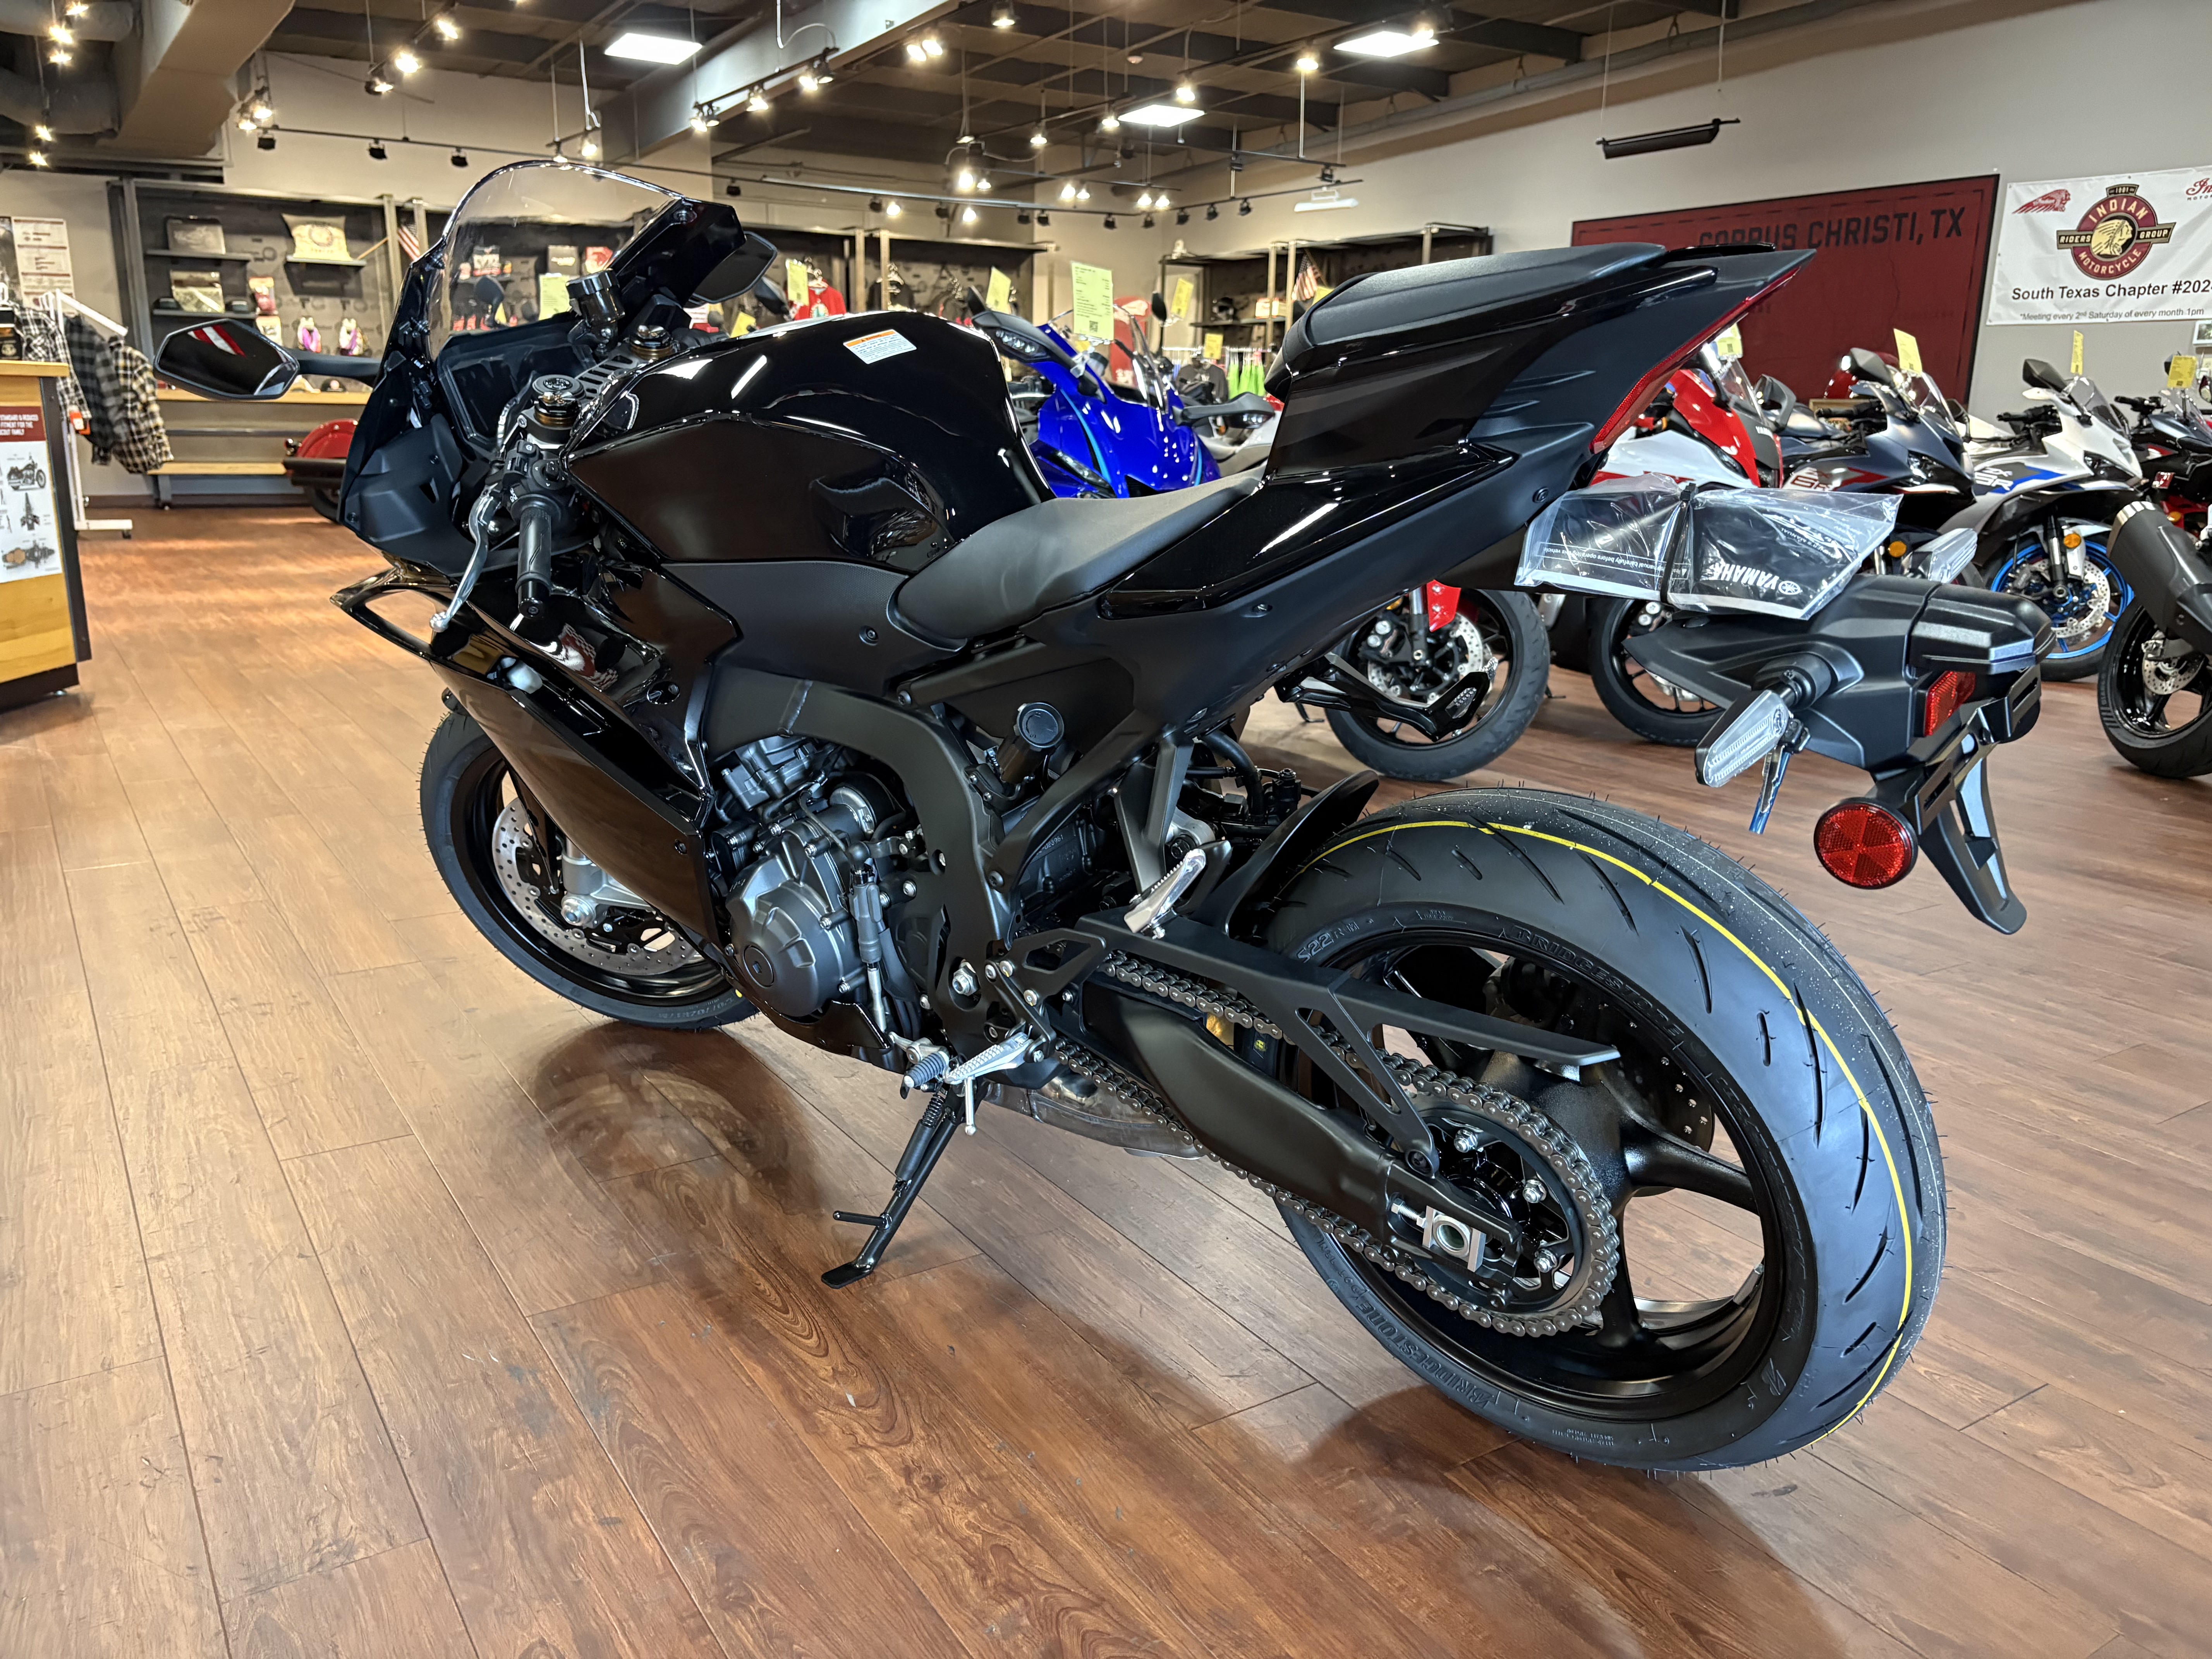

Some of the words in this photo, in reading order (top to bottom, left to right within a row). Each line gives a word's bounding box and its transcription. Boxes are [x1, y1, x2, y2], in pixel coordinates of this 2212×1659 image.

[2088, 198, 2148, 223] INDIAN
[1808, 212, 1923, 248] CHRISTI,
[1930, 206, 1965, 239] TX
[2059, 235, 2091, 243] RIDERS
[2140, 229, 2168, 239] GROUP
[2078, 249, 2142, 274] MOTORCYCLE
[2012, 287, 2054, 300] South
[2059, 286, 2100, 299] Texas
[2106, 284, 2168, 299] Chapter
[2172, 279, 2212, 294] #202
[2088, 311, 2123, 319] Saturday
[1597, 555, 1615, 564] before
[1356, 1301, 1491, 1409] BRIDGESTONE
